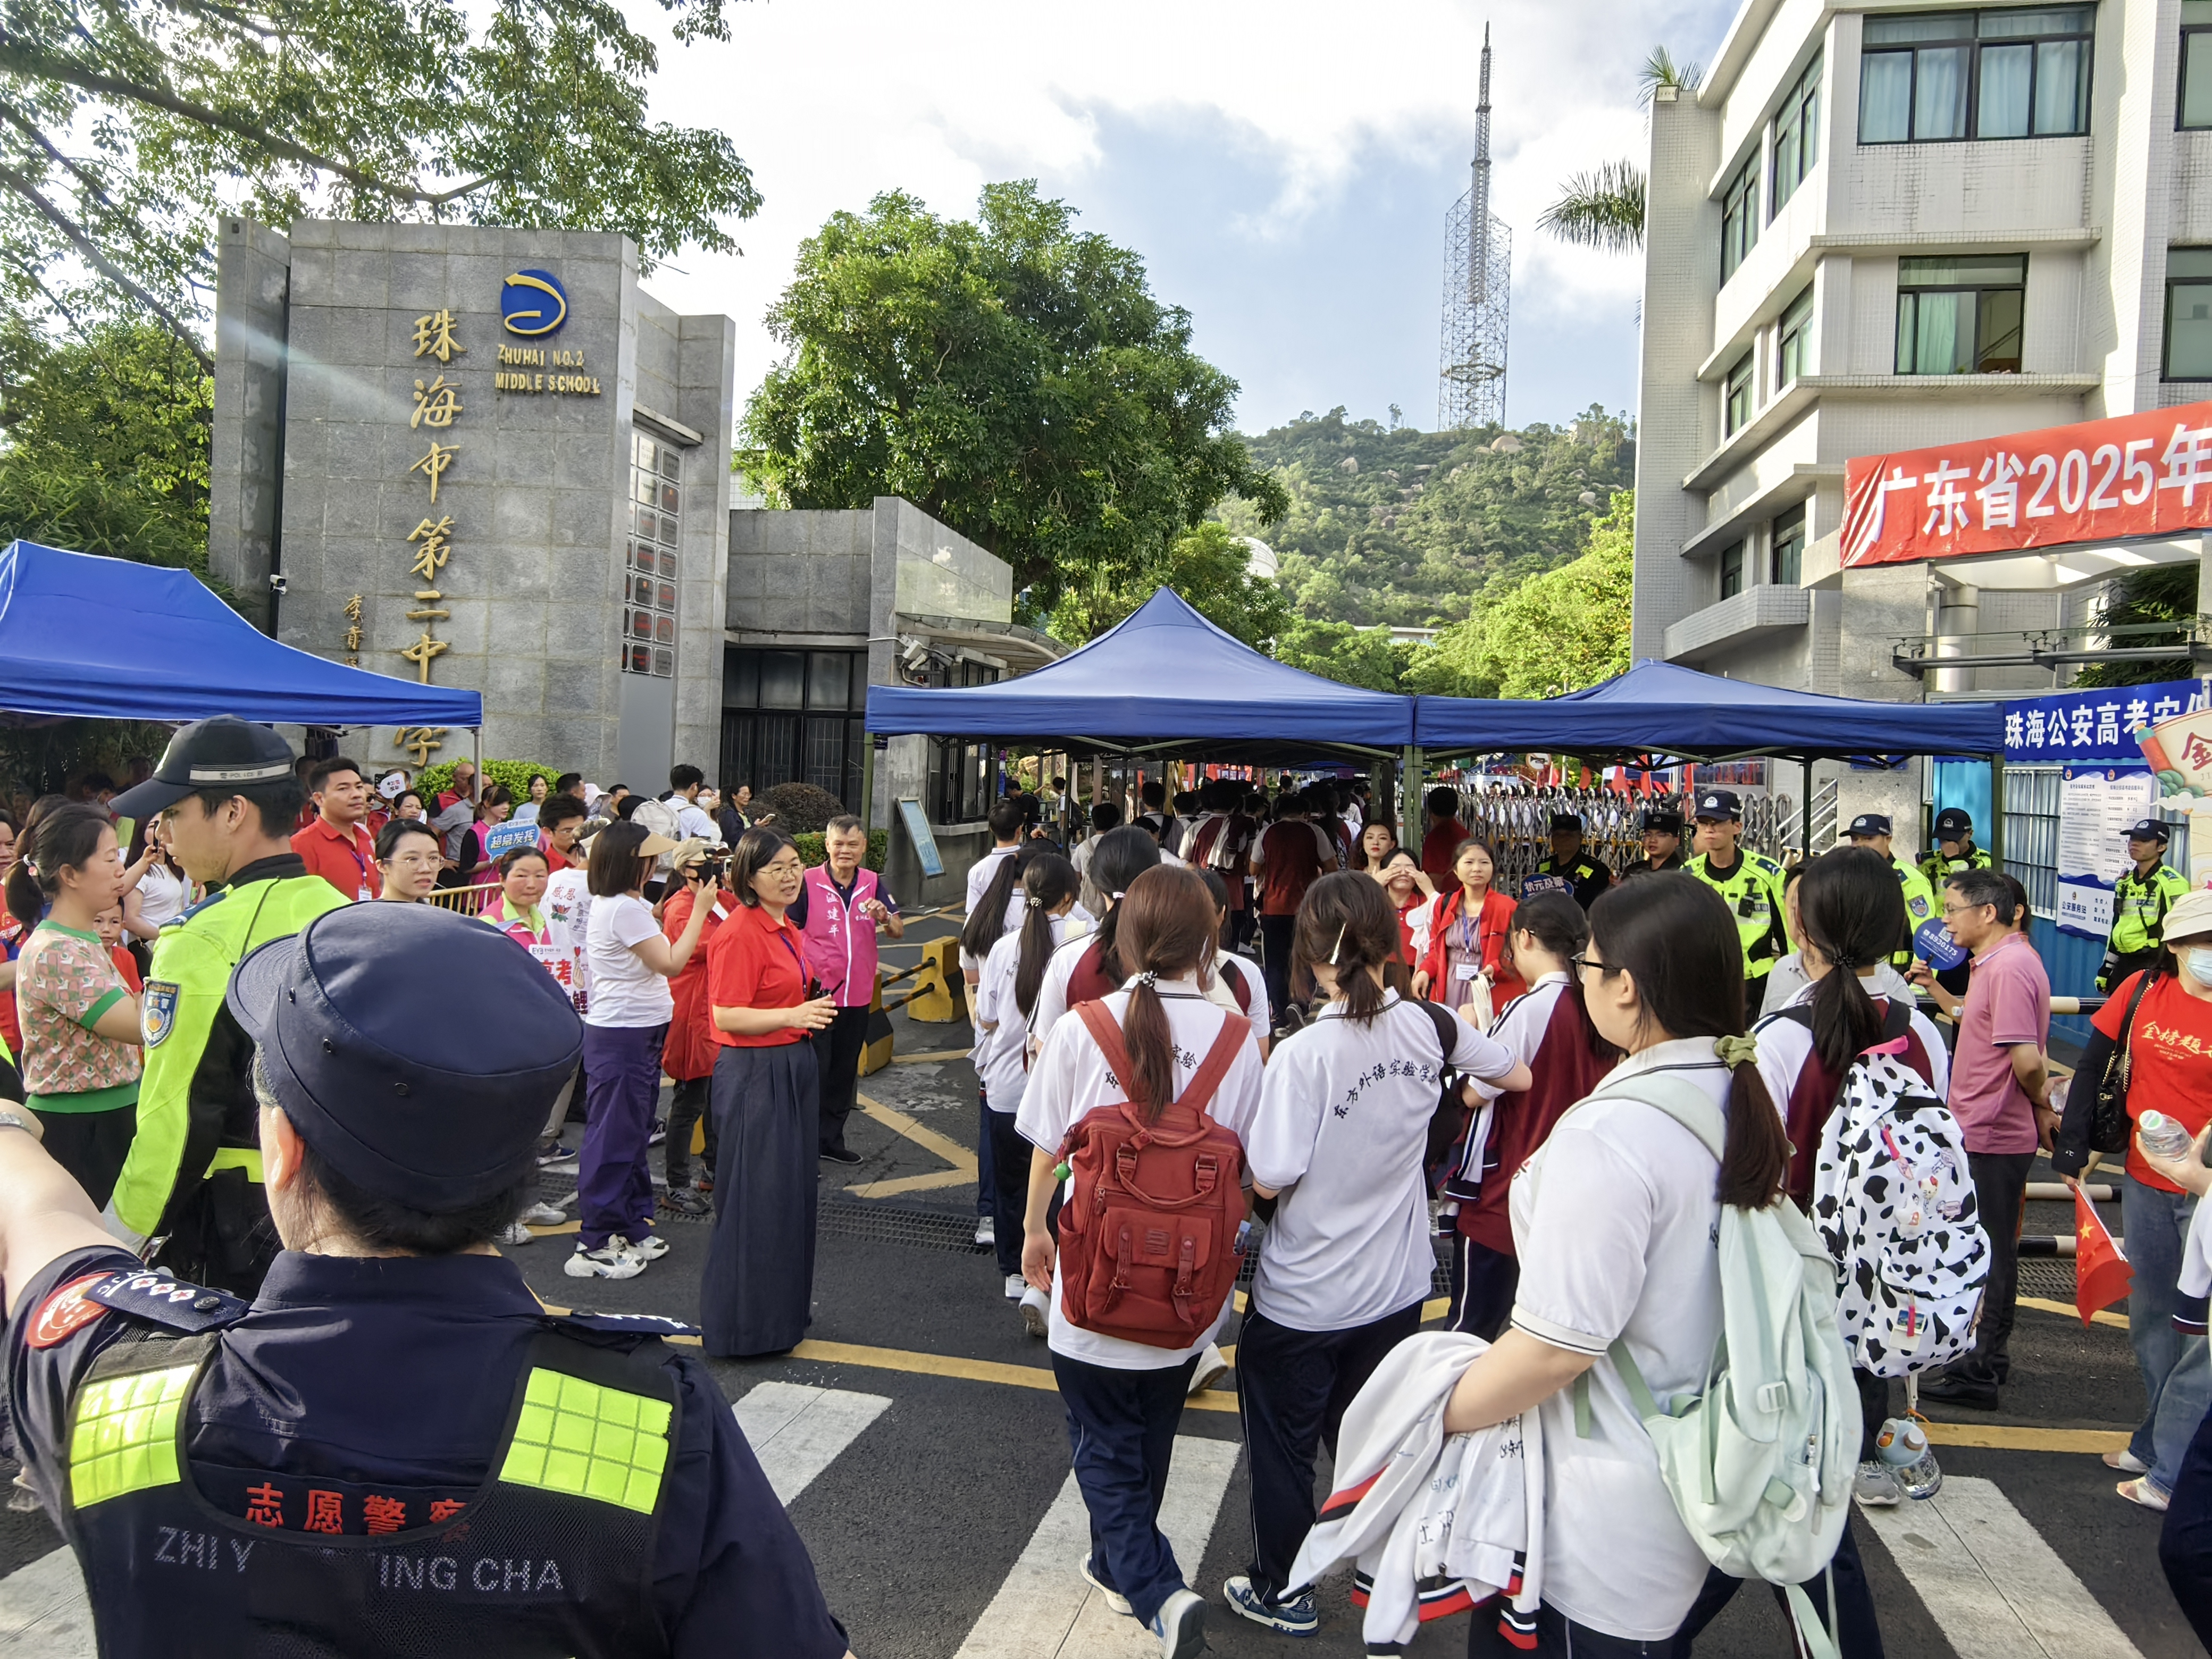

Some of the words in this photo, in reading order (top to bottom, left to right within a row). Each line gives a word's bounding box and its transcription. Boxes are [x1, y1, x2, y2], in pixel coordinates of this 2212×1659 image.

[495, 372, 543, 390] MIDDLE
[548, 375, 601, 394] SCHOOL
[497, 343, 545, 367] ZHUHAI
[552, 350, 584, 367] NO.2
[1869, 424, 2212, 542] 广东省2025年
[395, 308, 467, 767] 珠海市第二中学
[155, 1526, 219, 1570] ZHI
[472, 1557, 564, 1591] CHA
